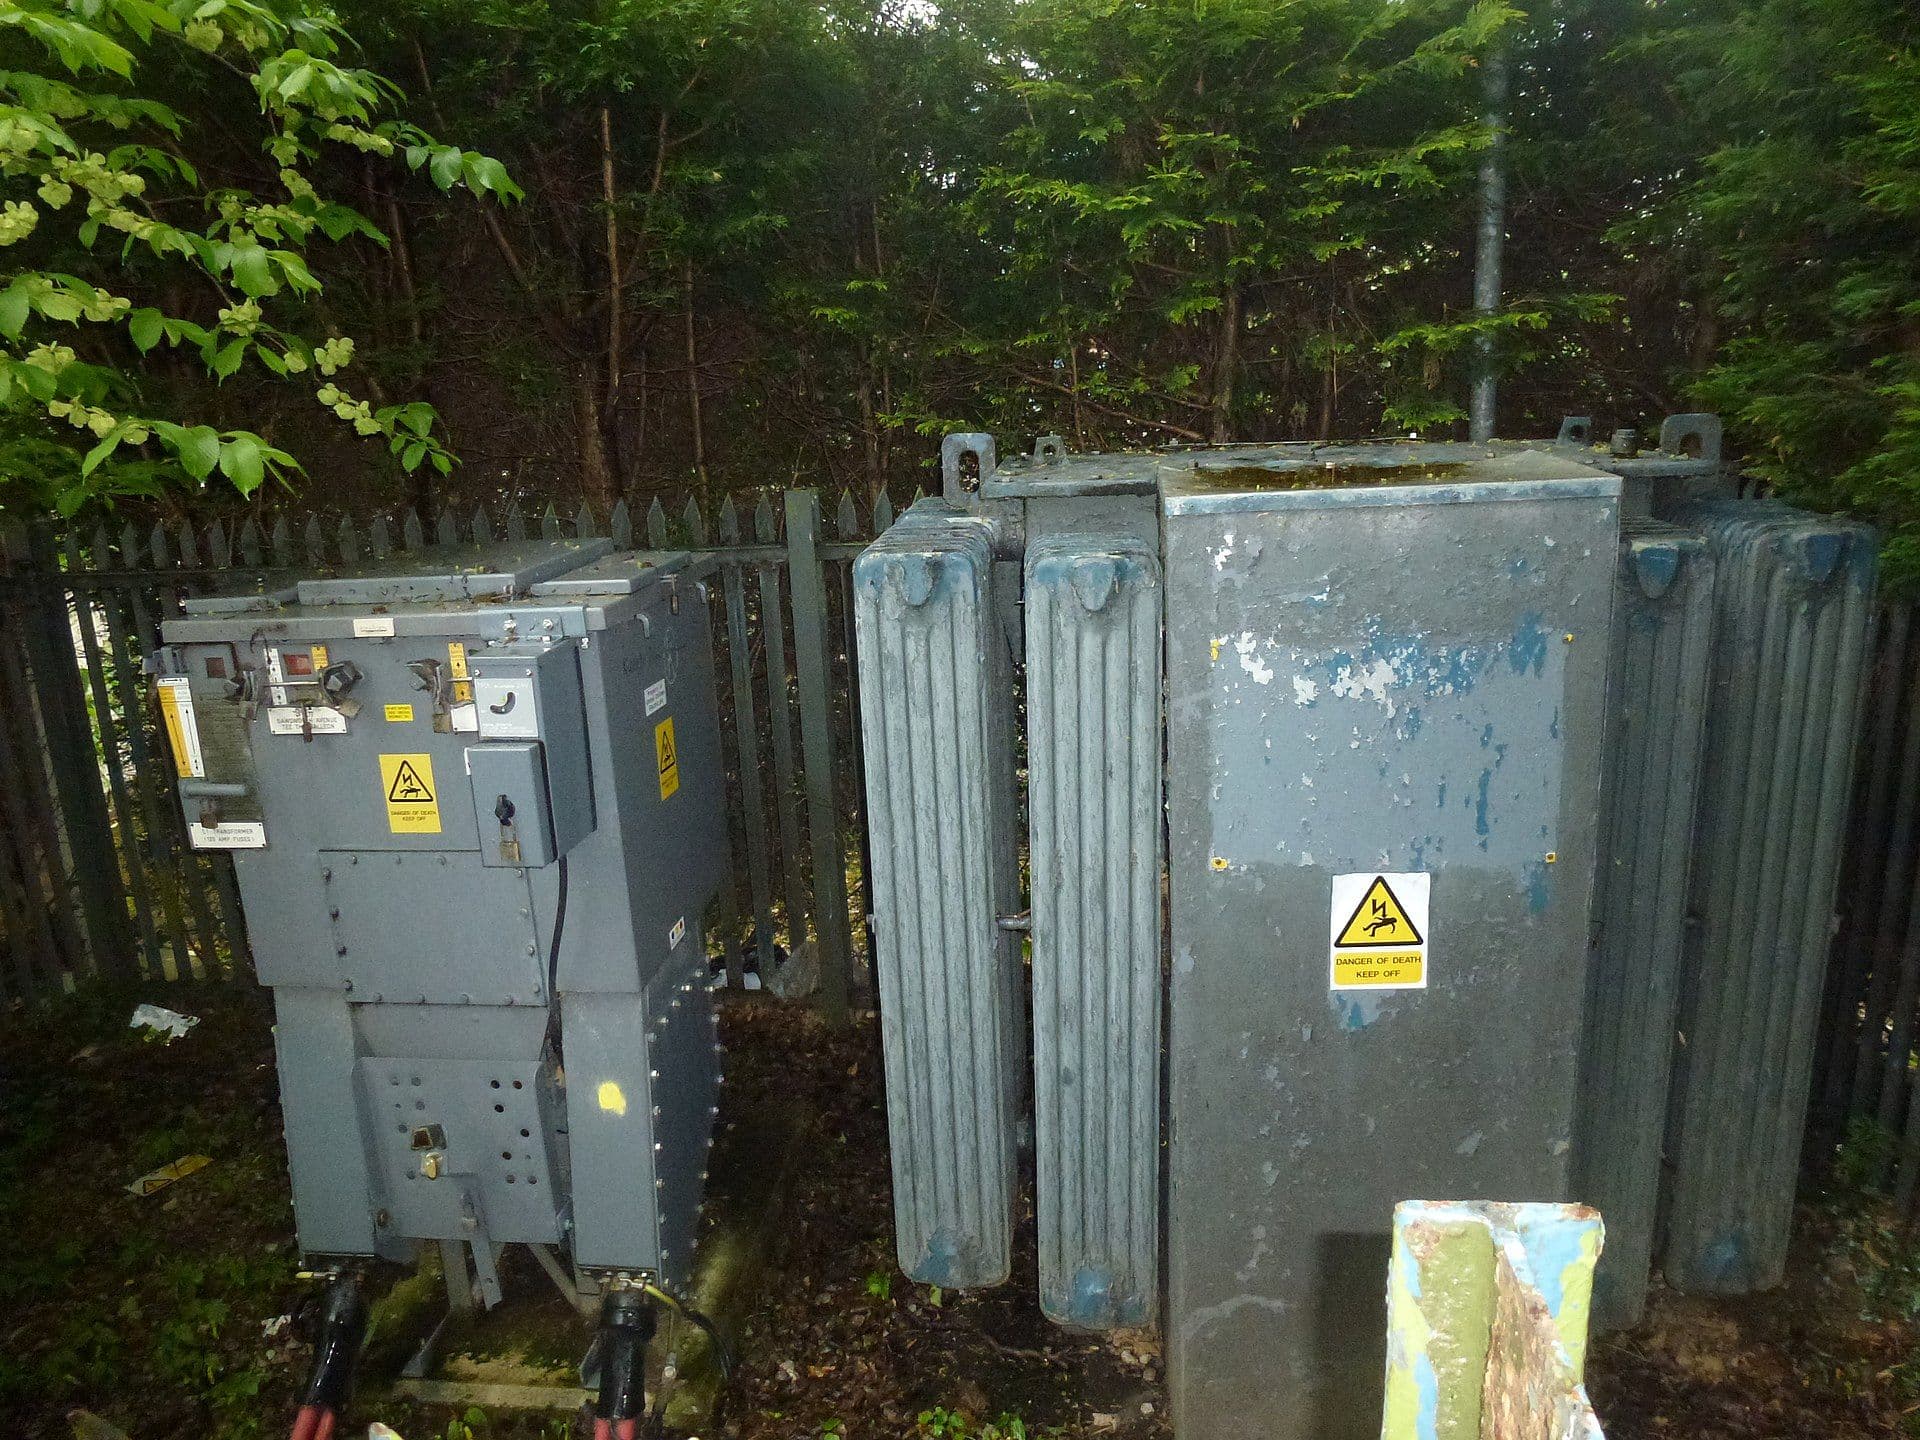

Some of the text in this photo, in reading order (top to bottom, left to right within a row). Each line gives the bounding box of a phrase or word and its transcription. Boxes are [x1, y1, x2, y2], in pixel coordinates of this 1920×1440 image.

[1336, 957, 1373, 965] DANGER
[1392, 956, 1421, 964] DEATH
[1356, 969, 1400, 978] KEEP OFF
